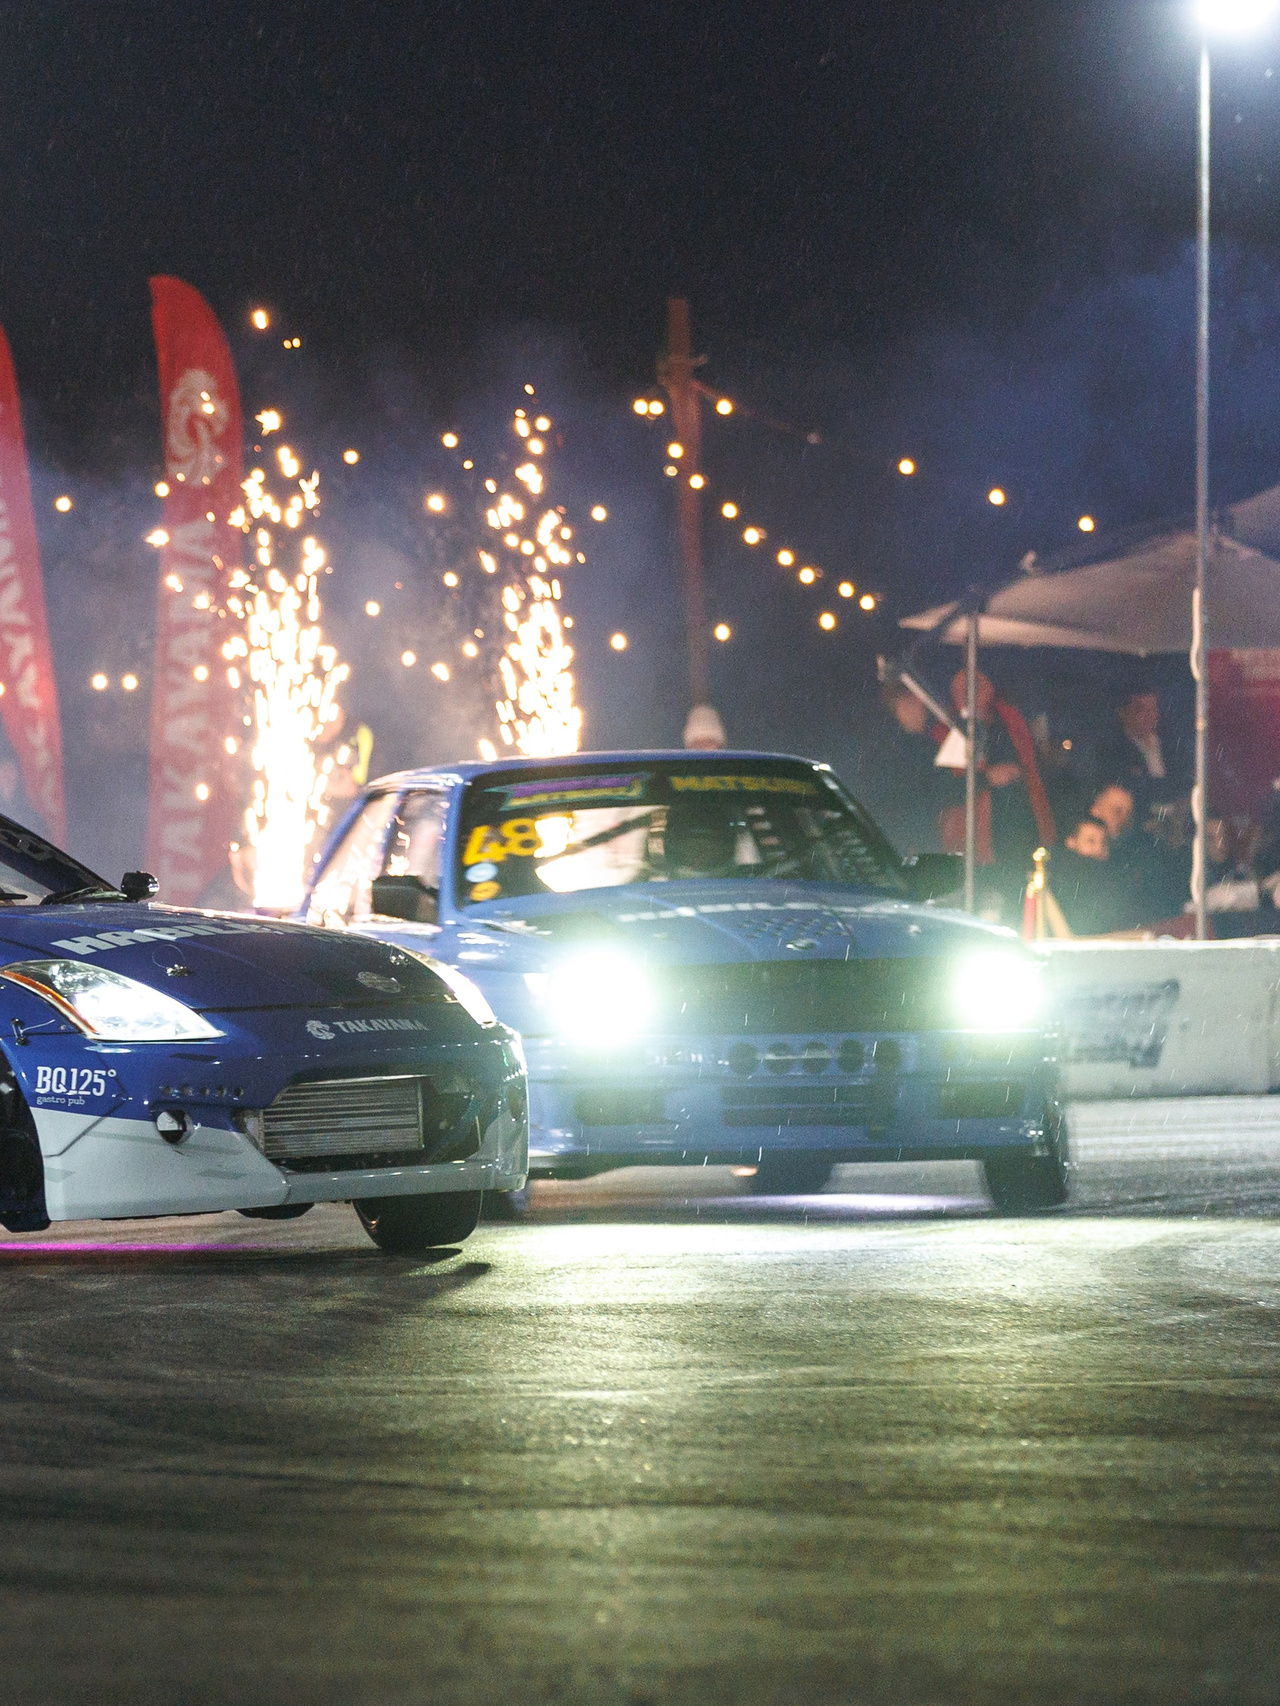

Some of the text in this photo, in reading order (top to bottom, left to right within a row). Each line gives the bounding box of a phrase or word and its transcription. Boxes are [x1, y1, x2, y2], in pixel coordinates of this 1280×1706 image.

[158, 516, 218, 902] TAKAYAMA
[332, 1018, 430, 1034] TAKAYAMA
[36, 1096, 85, 1106] gastro pub
